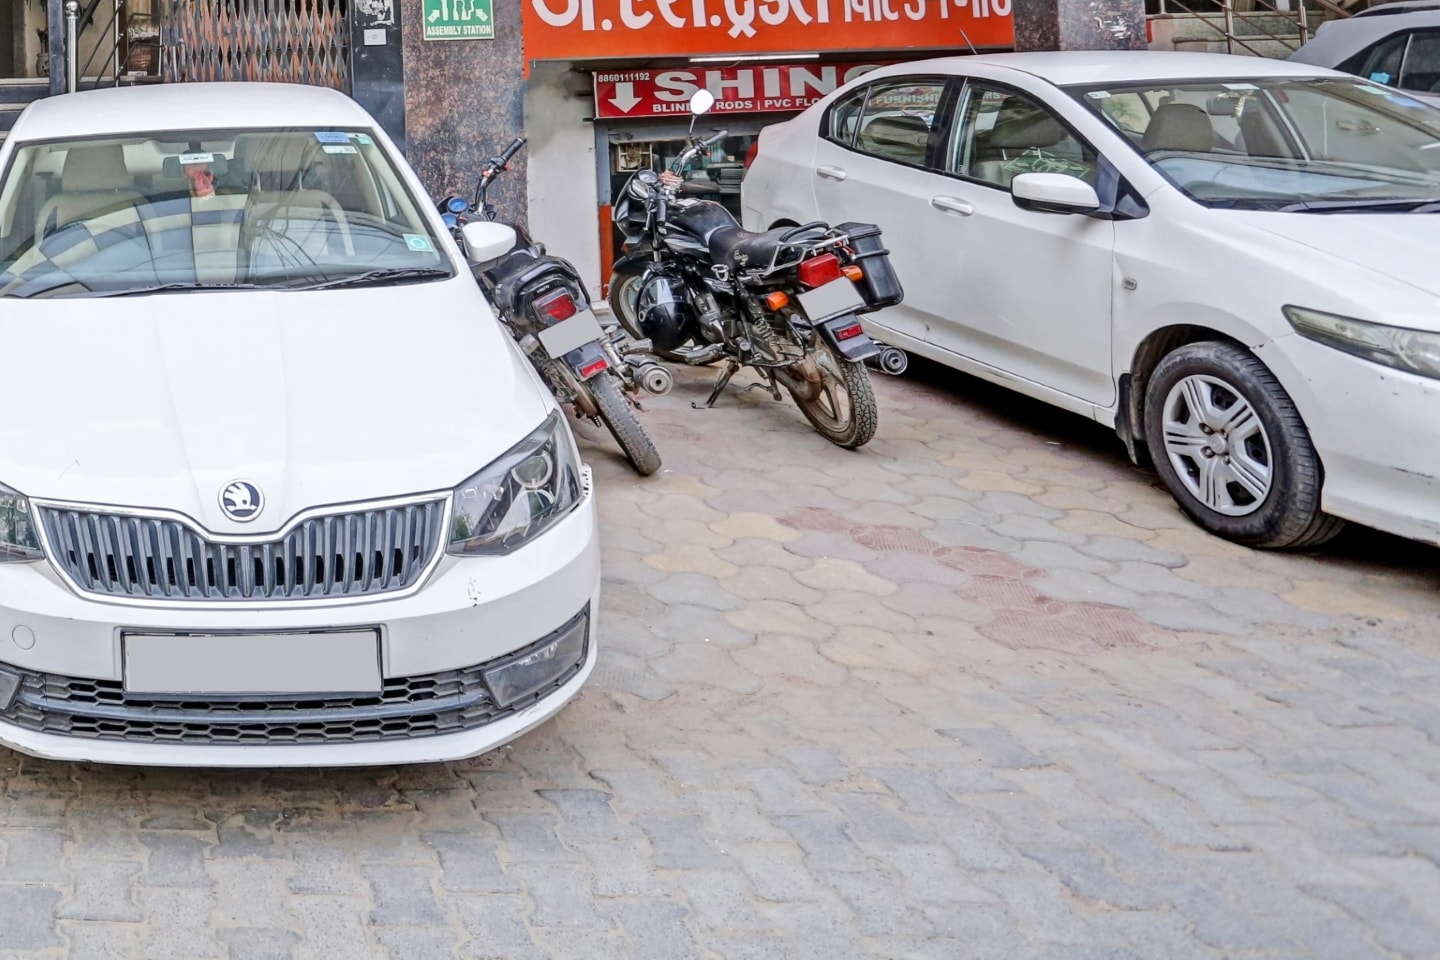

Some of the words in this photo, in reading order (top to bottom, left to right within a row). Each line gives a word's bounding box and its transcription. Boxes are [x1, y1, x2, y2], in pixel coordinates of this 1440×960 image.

[426, 25, 462, 36] ASSEMBLY
[462, 24, 492, 35] STATION
[597, 72, 650, 83] 8860111192
[715, 100, 753, 110] RODS
[765, 98, 791, 108] PVC
